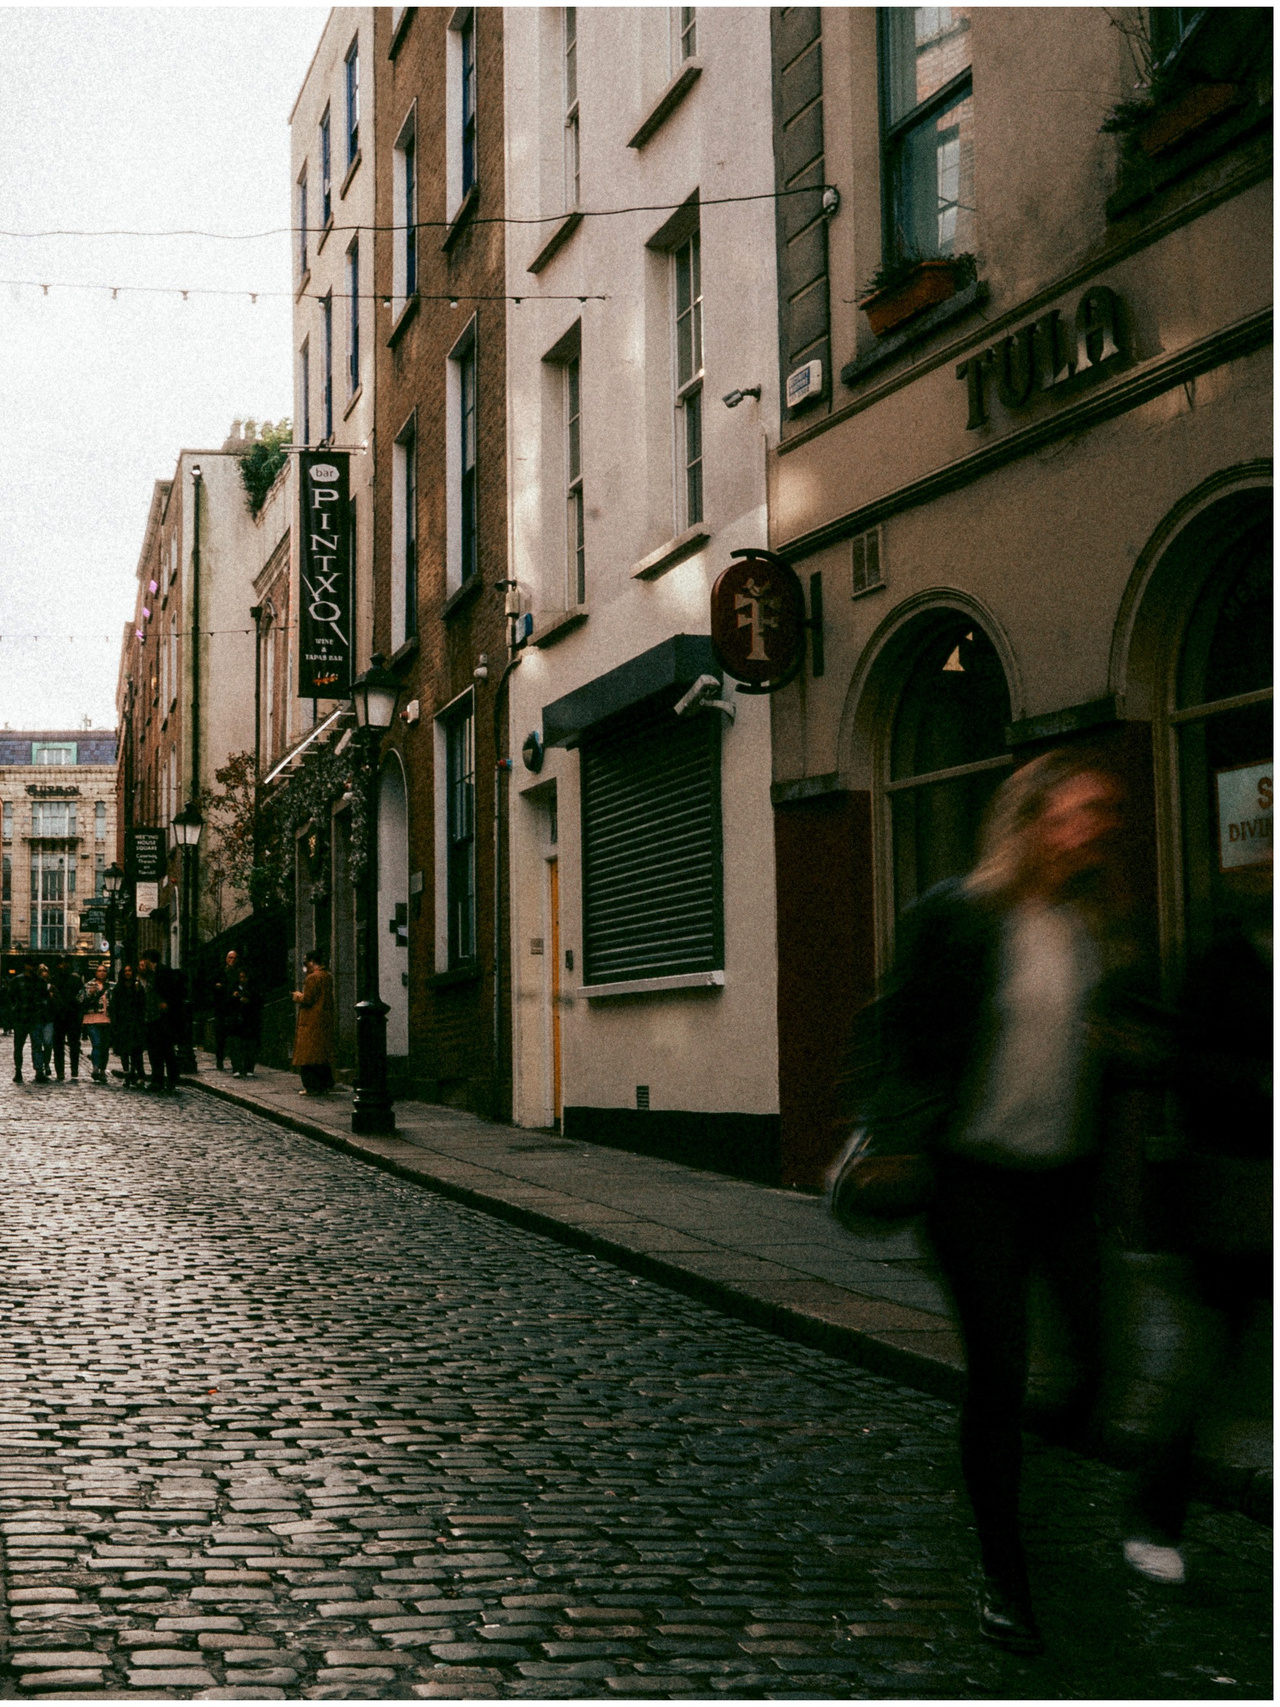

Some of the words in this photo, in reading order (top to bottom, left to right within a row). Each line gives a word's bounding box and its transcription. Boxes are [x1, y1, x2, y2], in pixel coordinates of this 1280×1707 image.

[956, 285, 1132, 431] TULA
[315, 467, 334, 477] bar
[305, 487, 345, 632] PINTXO
[304, 653, 327, 661] TAPAS
[328, 654, 344, 662] BAR
[1257, 776, 1273, 810] S
